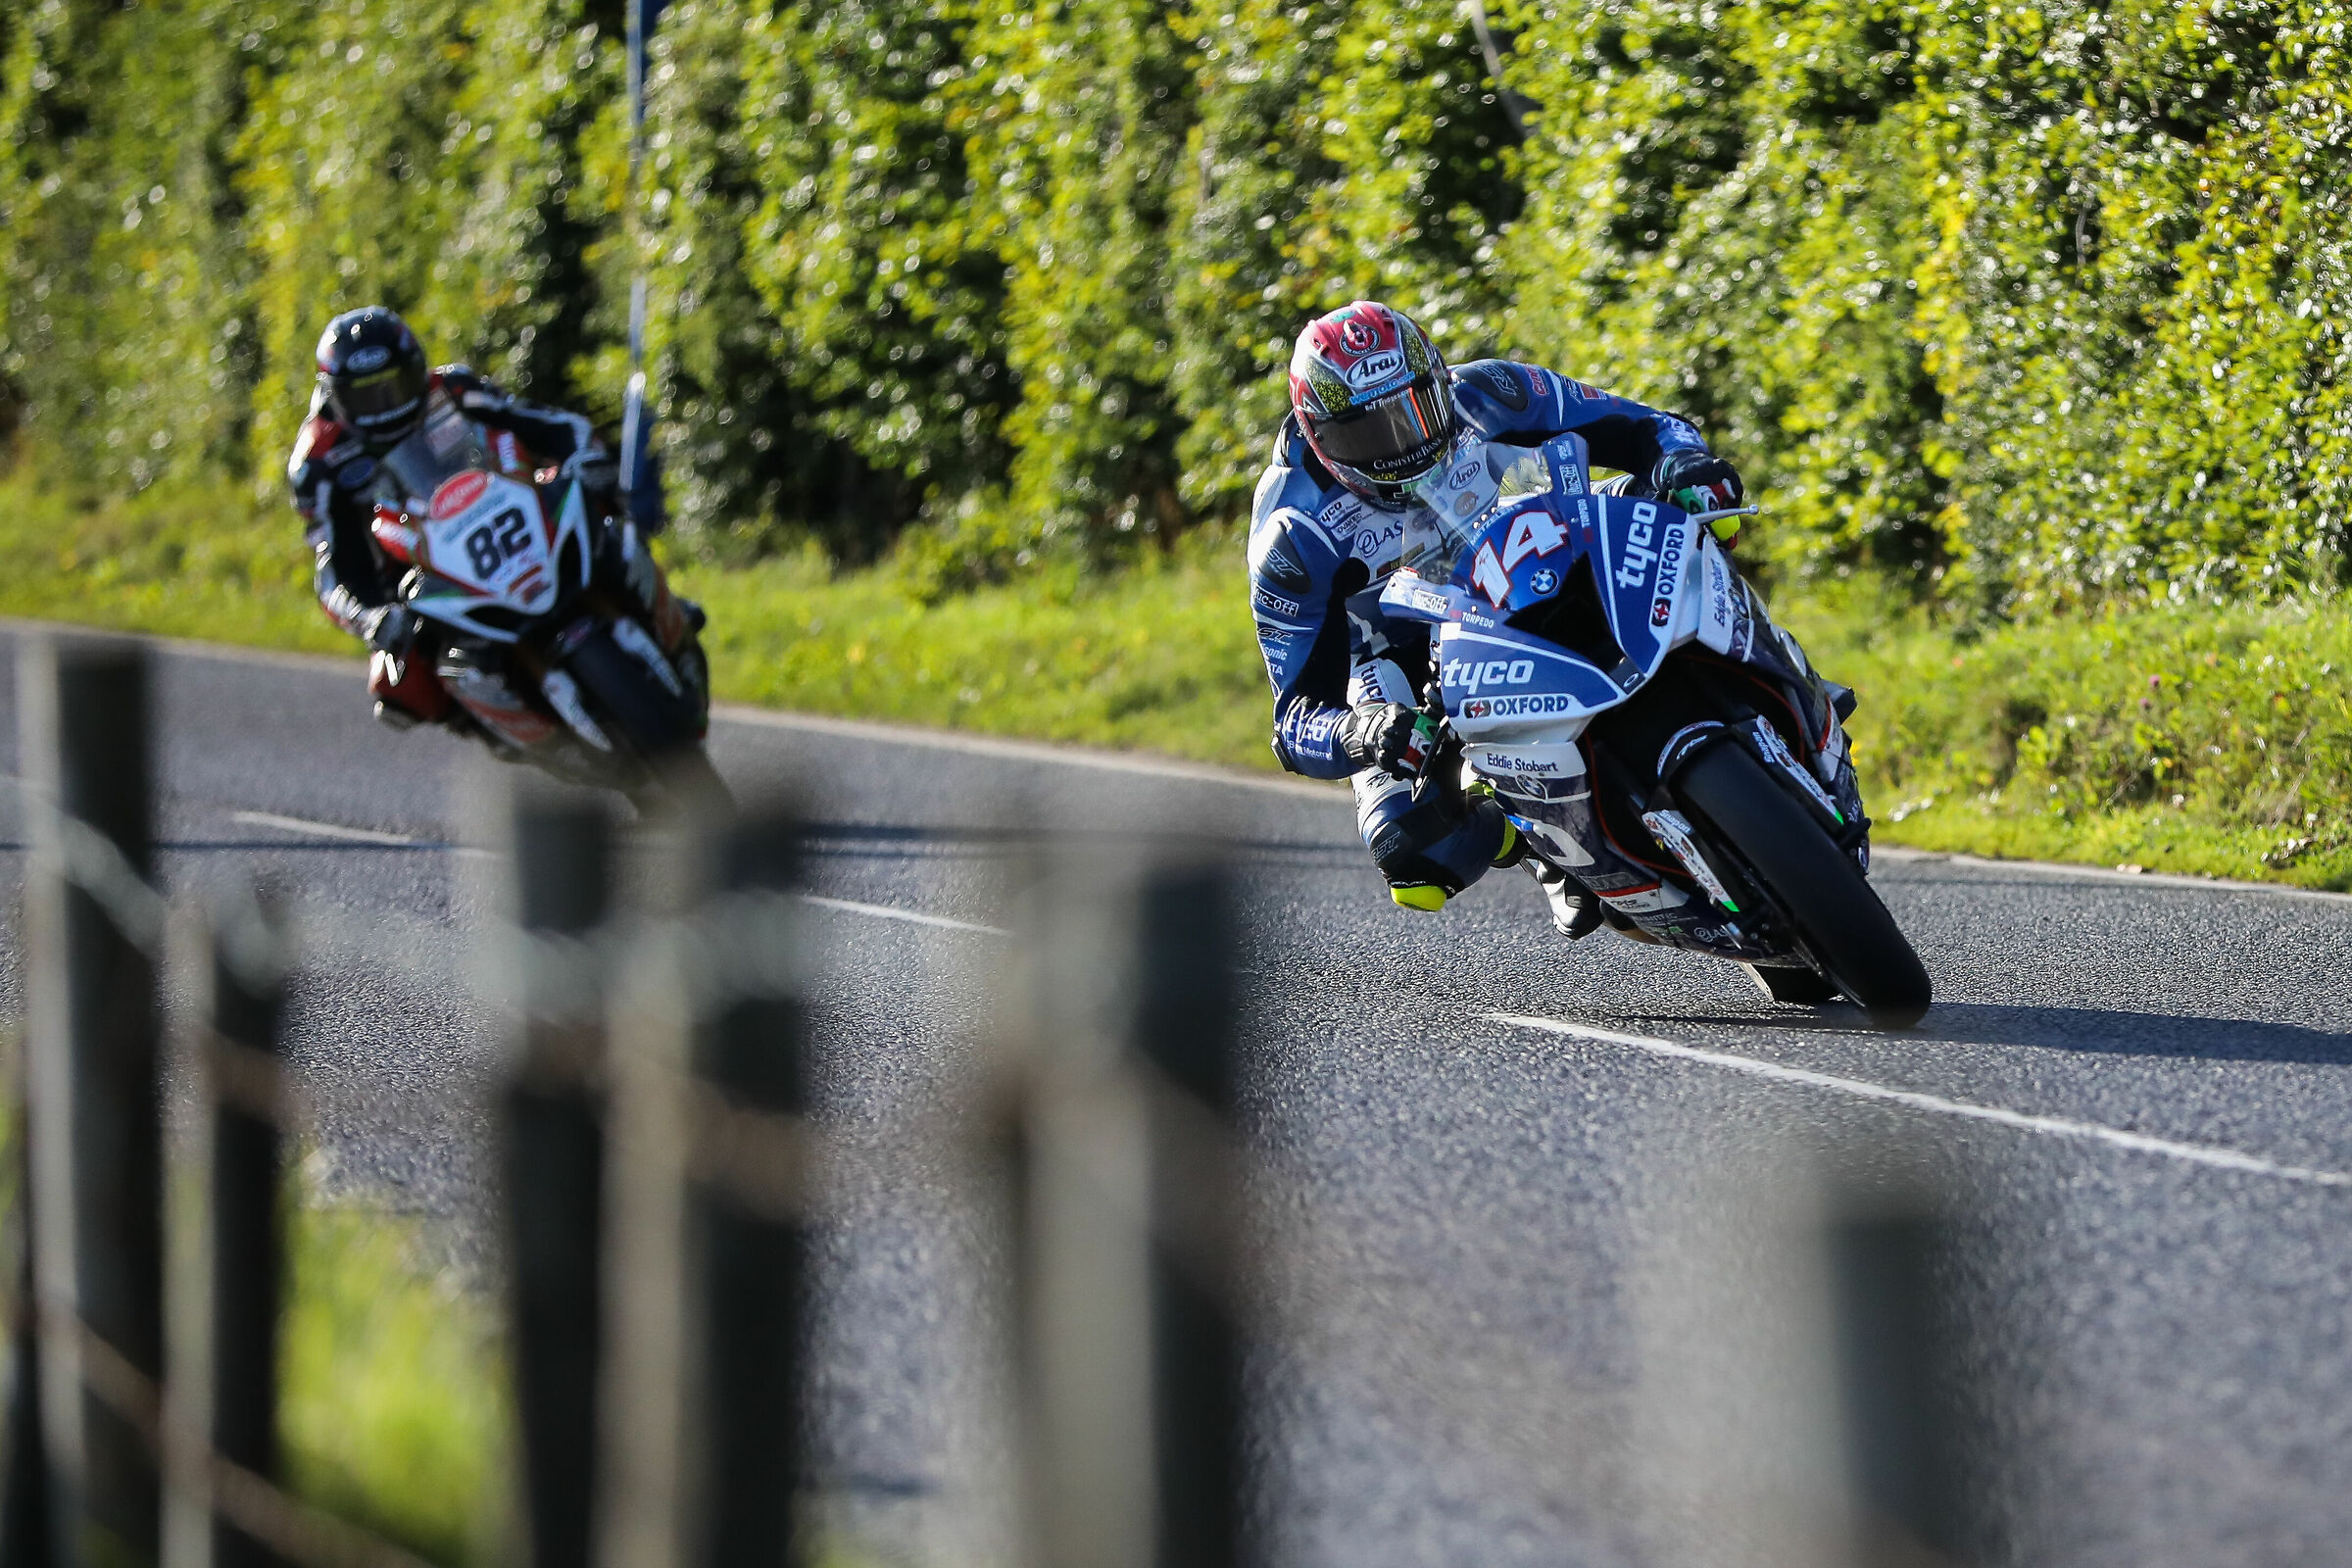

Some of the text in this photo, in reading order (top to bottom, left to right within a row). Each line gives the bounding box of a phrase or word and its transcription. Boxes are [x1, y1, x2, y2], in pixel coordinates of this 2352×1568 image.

[1356, 356, 1397, 378] Arai
[1320, 501, 1343, 522] yco
[467, 508, 531, 580] 82
[1615, 501, 1657, 589] tyco
[1471, 511, 1568, 609] 14
[1657, 527, 1686, 595] OXFORD
[1254, 588, 1297, 616] uc-Off
[1461, 612, 1494, 628] TORPEDO
[1358, 665, 1384, 700] tyc
[1443, 658, 1535, 695] tyco
[1493, 696, 1568, 715] OXFORD
[1487, 753, 1559, 772] Eddie Stobart
